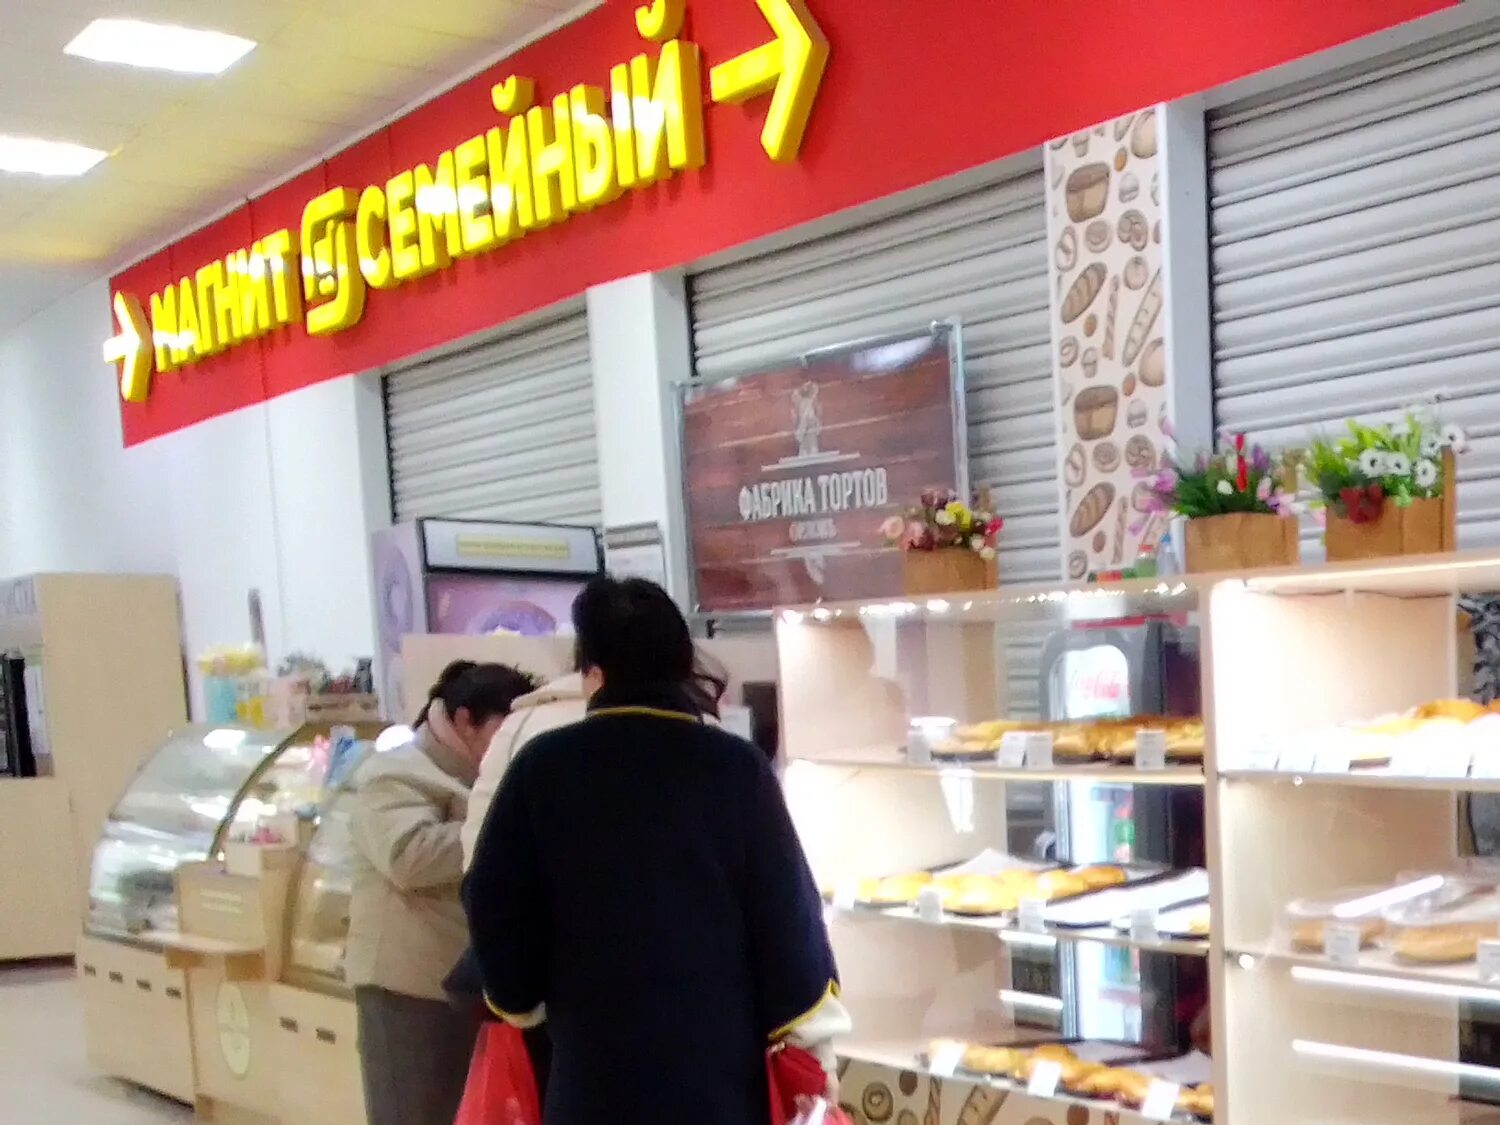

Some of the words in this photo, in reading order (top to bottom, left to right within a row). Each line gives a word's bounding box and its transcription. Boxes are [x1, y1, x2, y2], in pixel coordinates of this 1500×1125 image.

[150, 228, 297, 373] МАГНИТ
[355, 0, 704, 290] СЕМЕЙНЫЙ
[738, 476, 816, 521] ФАБРИКА
[817, 467, 888, 513] ТОРТОВ
